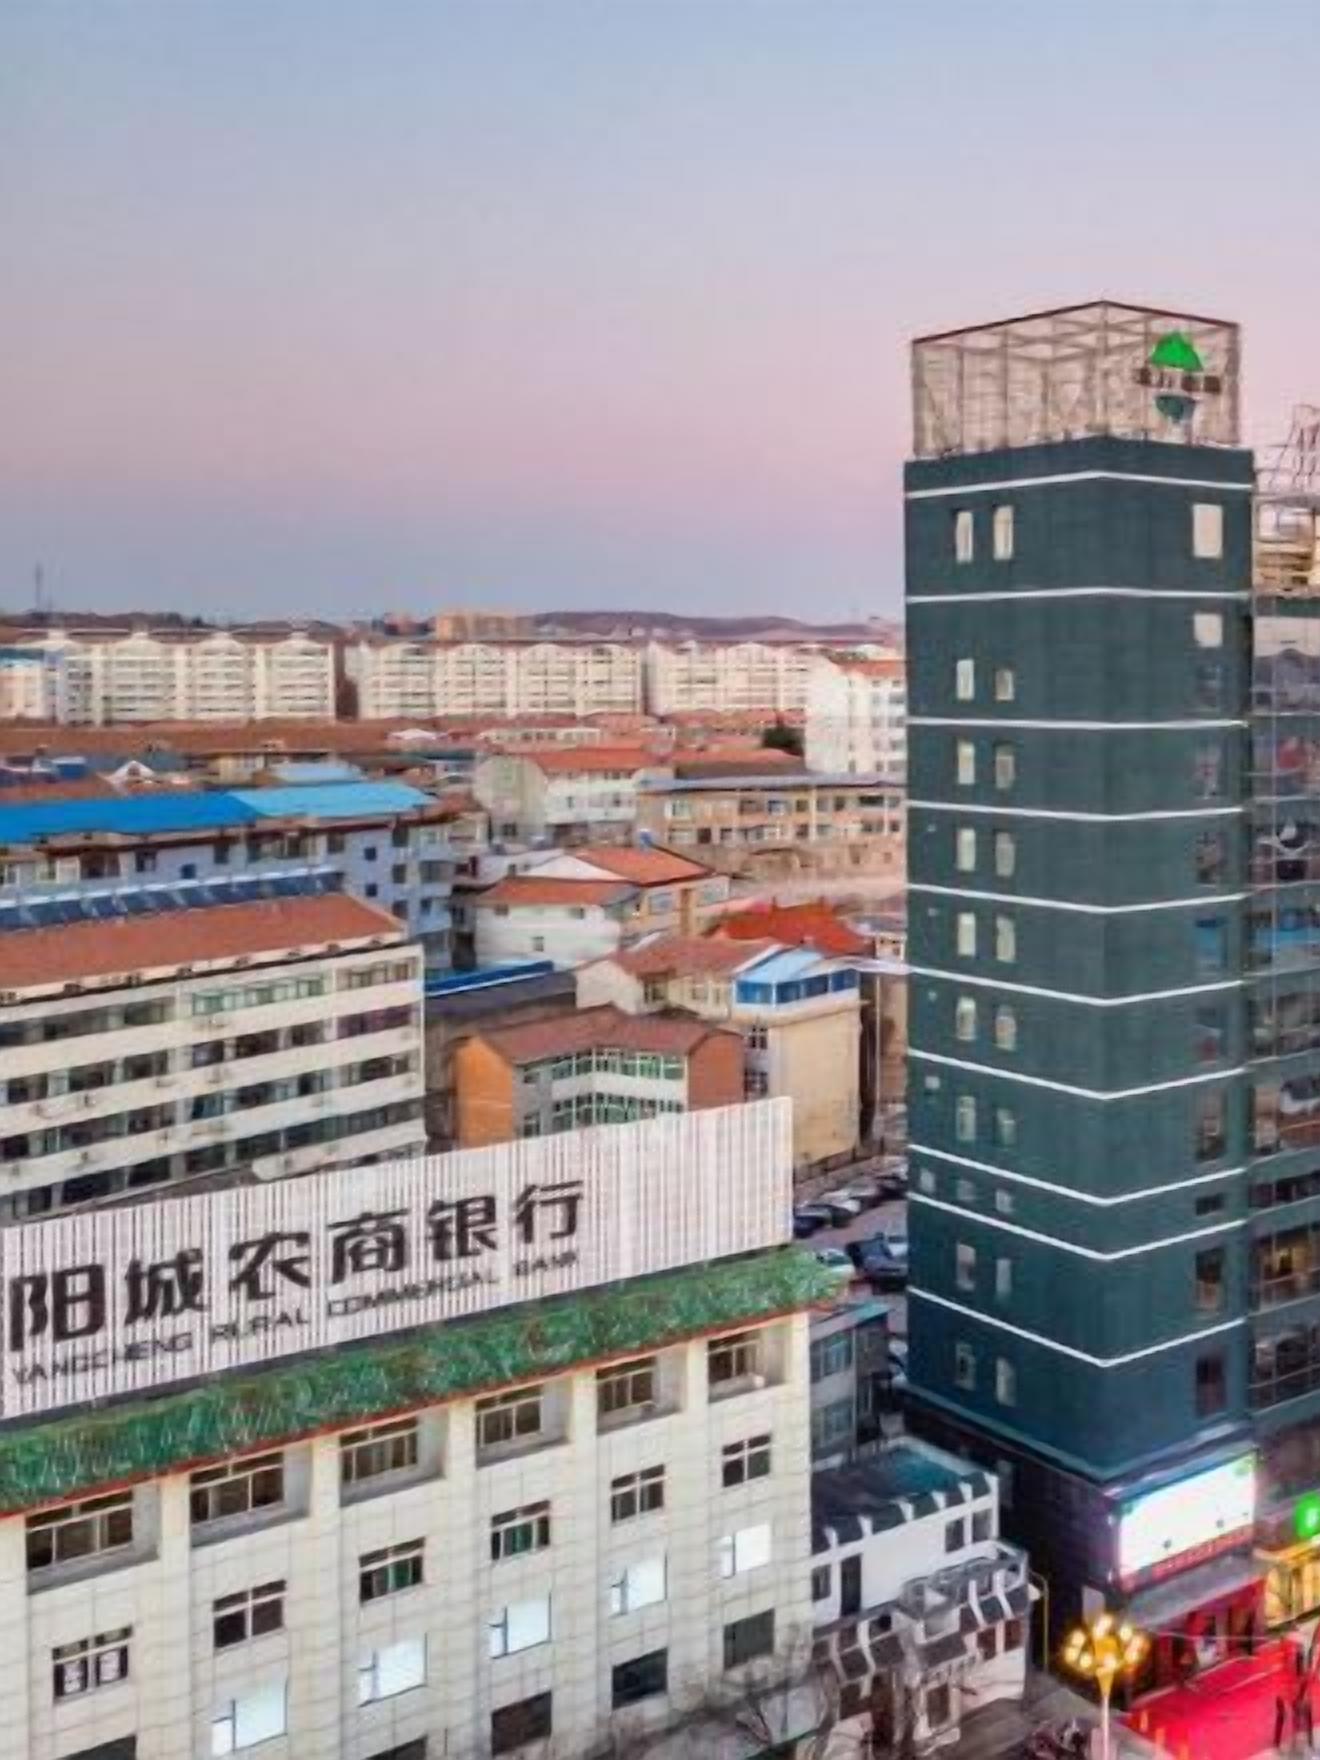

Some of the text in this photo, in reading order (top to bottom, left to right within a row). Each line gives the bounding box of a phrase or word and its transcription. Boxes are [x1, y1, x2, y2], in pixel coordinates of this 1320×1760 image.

[9, 1180, 584, 1351] 阳城农商银行
